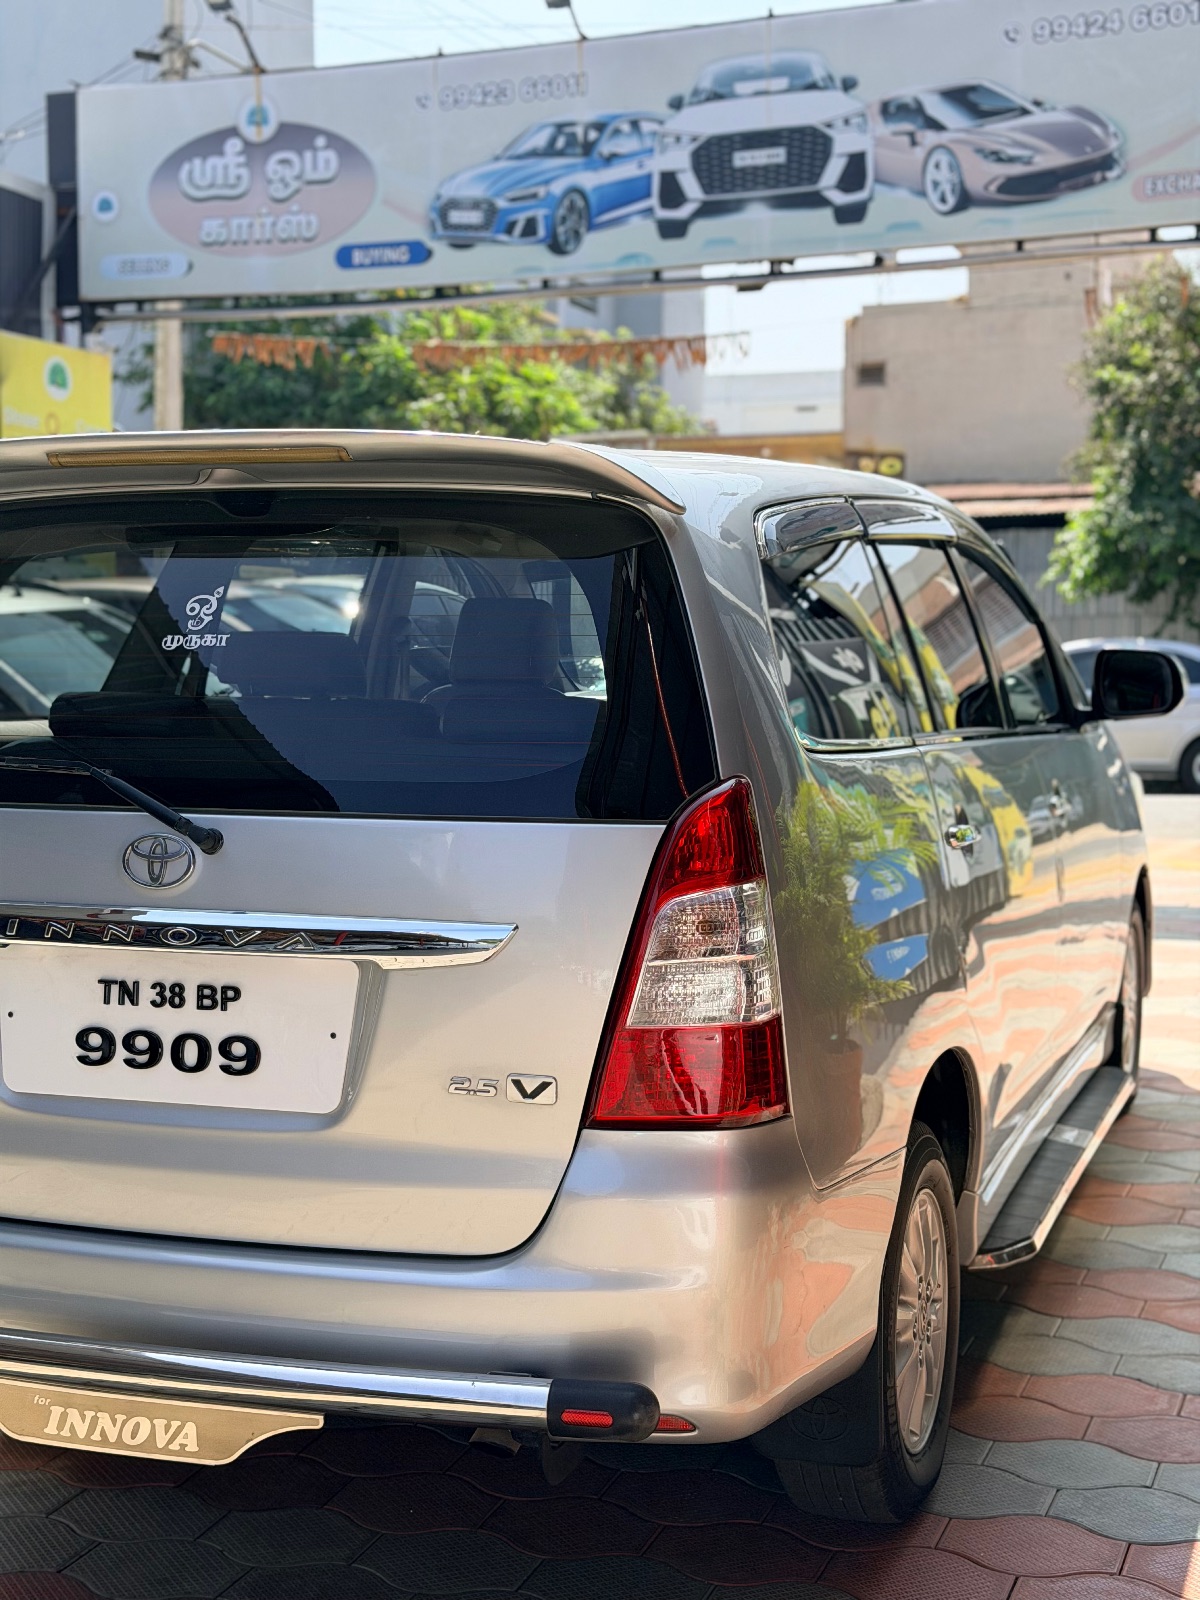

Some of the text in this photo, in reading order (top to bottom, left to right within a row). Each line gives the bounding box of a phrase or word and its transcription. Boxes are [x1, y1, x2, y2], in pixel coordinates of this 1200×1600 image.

[1032, 1, 1200, 44] 99424 6601
[199, 204, 320, 246] கார்ஸ்
[351, 245, 410, 266] BUYING
[161, 633, 231, 651] முருகா
[5, 917, 315, 951] INNOVA
[98, 979, 242, 1011] TN 38 BP
[75, 1026, 262, 1076] 9909
[448, 1075, 554, 1100] 2.5 V
[33, 1395, 51, 1406] for
[43, 1405, 200, 1453] INNOVA
